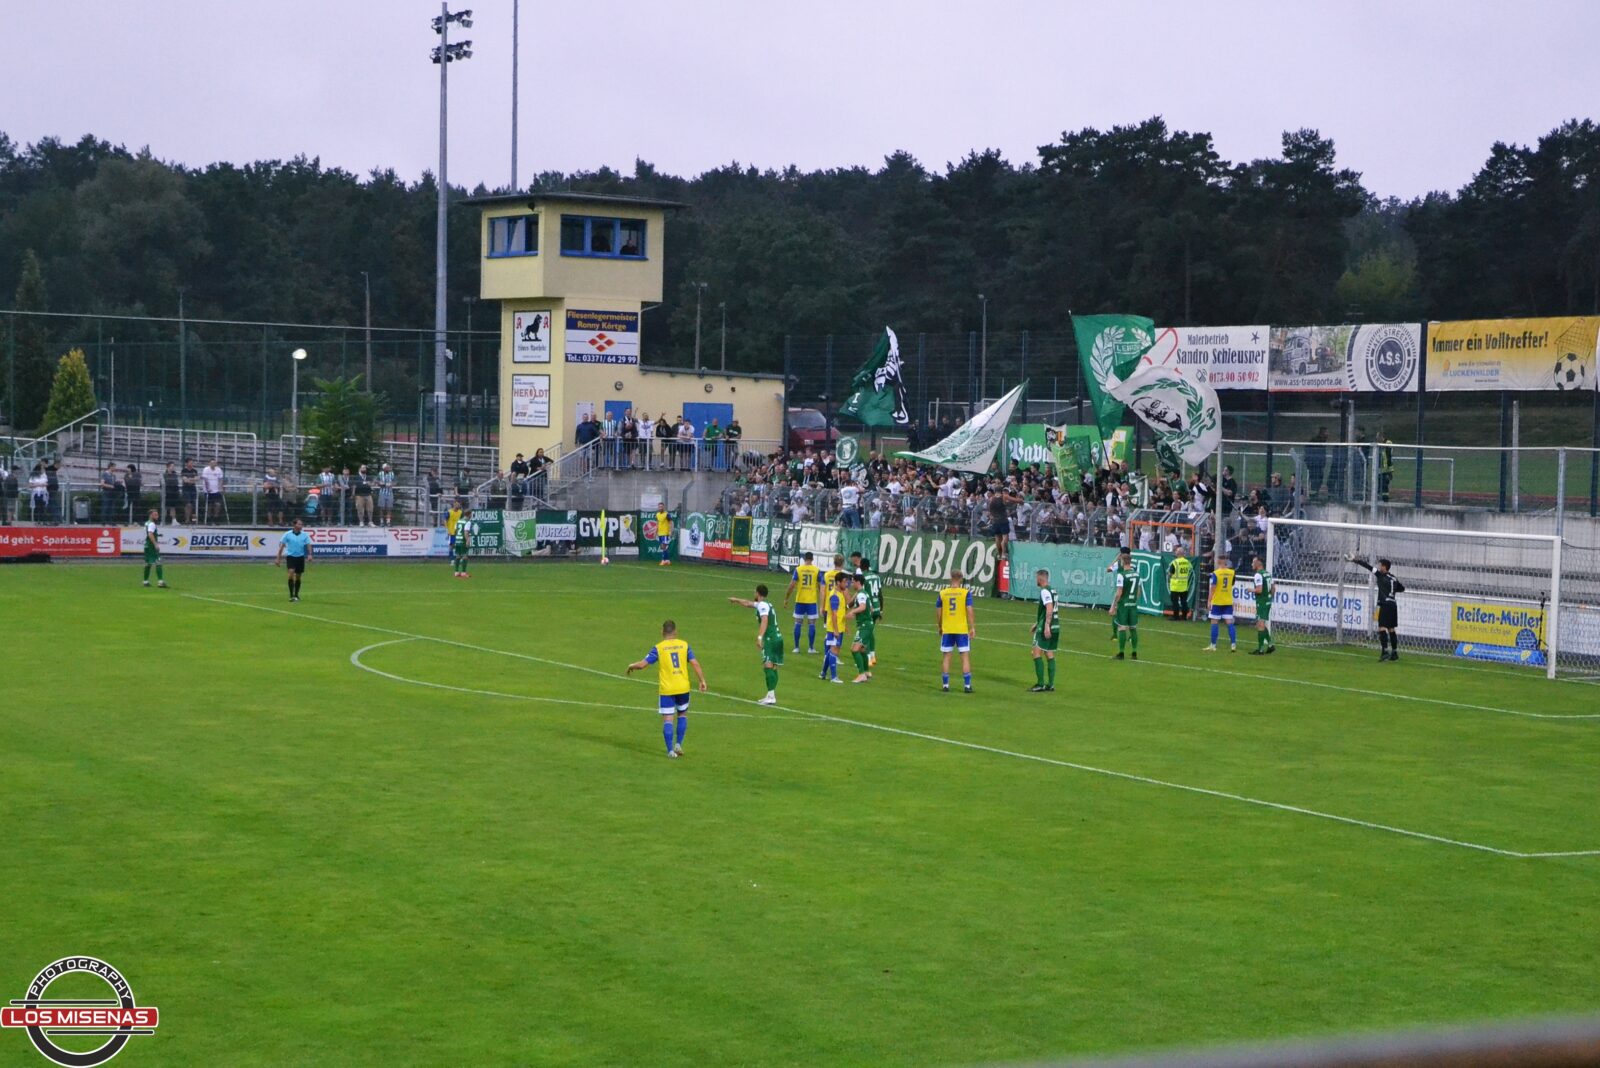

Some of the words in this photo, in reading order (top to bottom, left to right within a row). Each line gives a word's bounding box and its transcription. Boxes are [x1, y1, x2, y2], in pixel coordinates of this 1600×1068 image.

[568, 311, 636, 322] Fliesenlegermeister
[577, 322, 600, 330] Ronny
[1188, 334, 1229, 346] Malerbetrieb
[1384, 328, 1410, 348] STREETS
[1432, 337, 1464, 352] Immer
[1466, 333, 1482, 350] ein
[1486, 331, 1549, 350] Volltreffer!
[1177, 348, 1208, 364] Sandro
[1212, 348, 1266, 364] Schleusner
[1379, 352, 1402, 366] A.S.S.
[1274, 378, 1342, 388] www.ass-transporte.de
[458, 524, 462, 535] 2
[537, 525, 576, 538] WURZEN
[580, 518, 618, 537] GWP
[12, 536, 34, 546] geht
[42, 535, 92, 546] Sparkasse
[304, 530, 348, 542] REST
[388, 529, 428, 540] REST
[191, 536, 248, 546] BAUSETRA
[705, 540, 732, 549] versicherun
[313, 546, 378, 554] www.restgmbh.de
[878, 534, 998, 582] DIABLOS
[802, 574, 812, 586] 31
[1130, 578, 1136, 594] 7
[1222, 578, 1228, 588] 9
[869, 580, 879, 596] 14
[949, 598, 957, 611] 5
[1457, 606, 1540, 628] Reifen-Müller
[671, 652, 680, 668] 8
